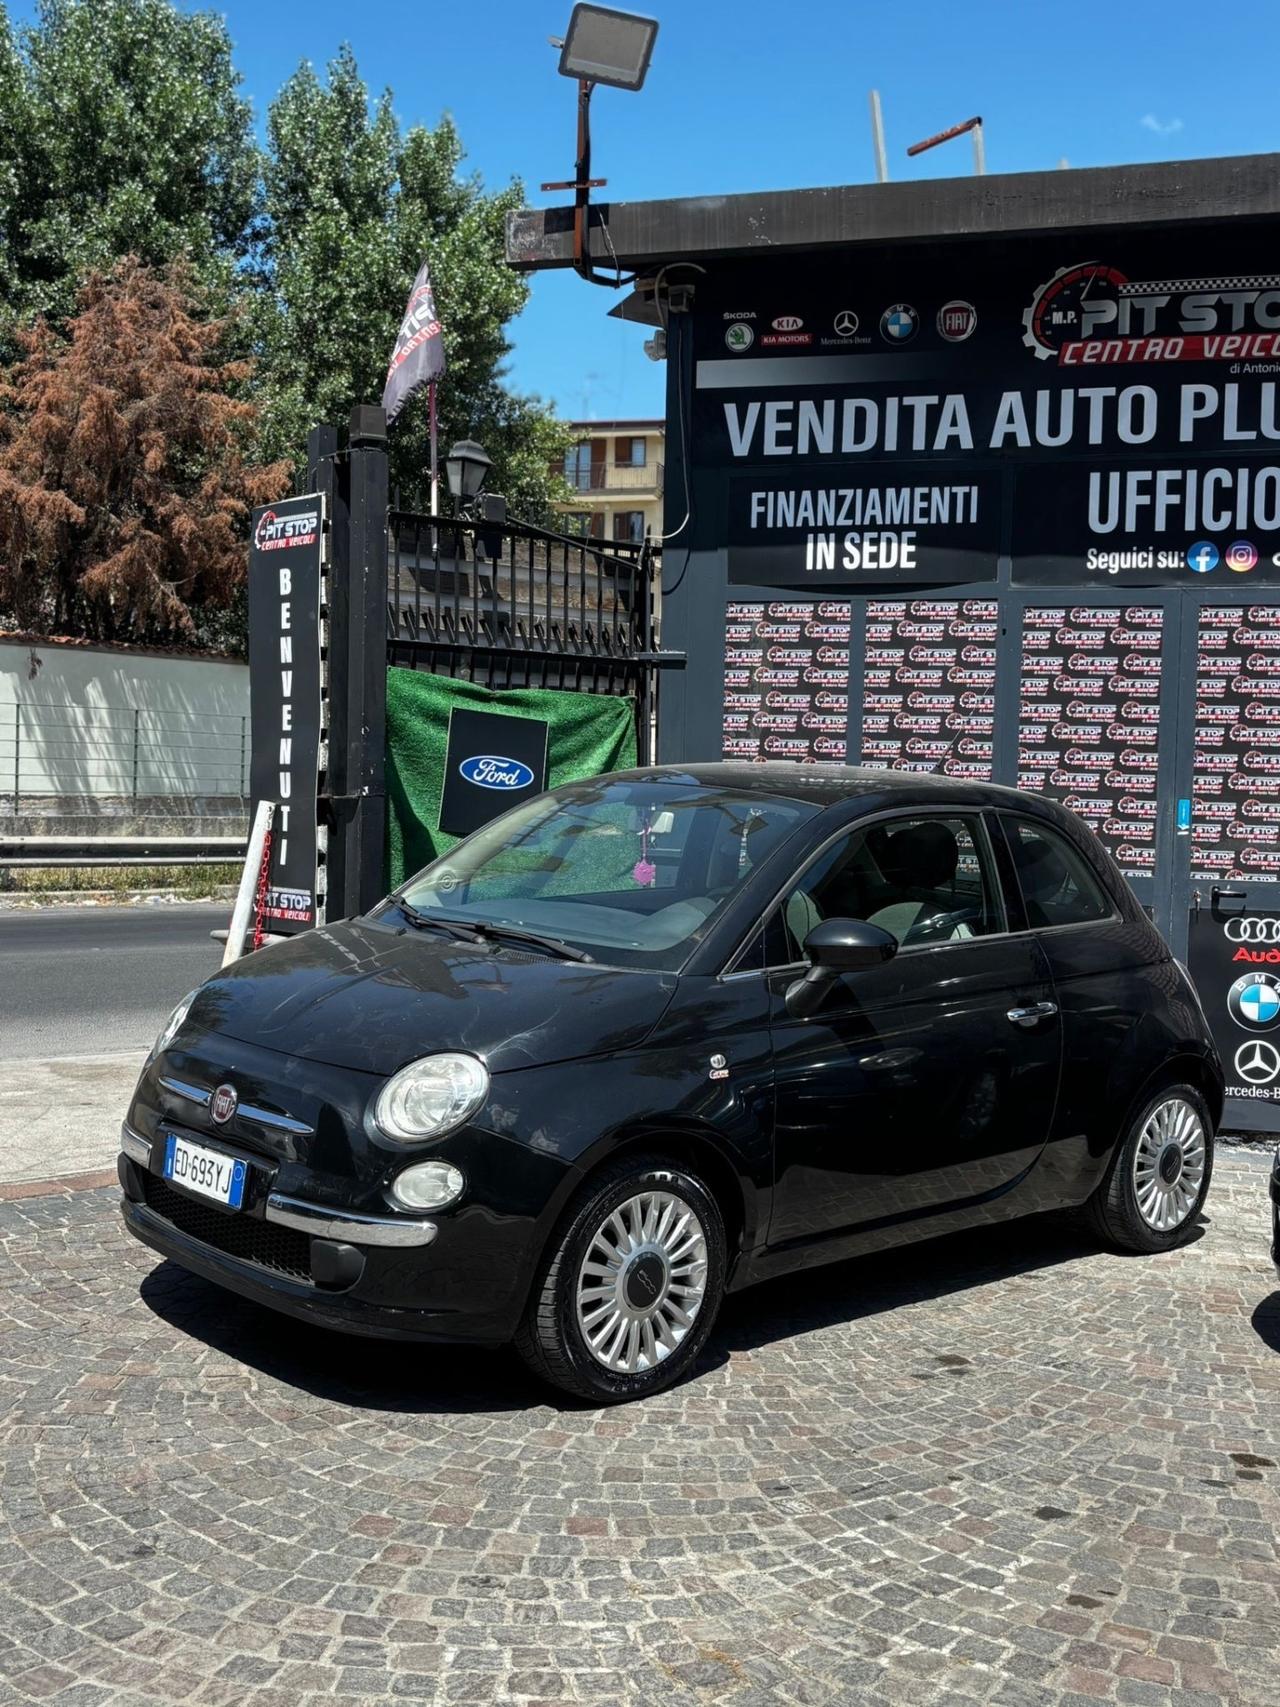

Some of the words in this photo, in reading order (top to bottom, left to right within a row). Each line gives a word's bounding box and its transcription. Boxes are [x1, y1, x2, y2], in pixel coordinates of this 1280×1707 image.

[945, 312, 969, 331] FIAT
[1080, 296, 1171, 339] PIT
[776, 319, 800, 328] KIA
[763, 336, 777, 344] KIA
[778, 334, 810, 343] MOTORS
[1230, 363, 1241, 374] di
[1243, 362, 1280, 373] Antoni
[723, 393, 975, 458] VENDITA
[989, 384, 1158, 449] AUTO
[750, 486, 979, 529] FINANZIAMENTI
[266, 523, 284, 540] PIT
[285, 518, 318, 537] STOP
[806, 538, 836, 570] IN
[842, 531, 917, 569] SEDE
[1087, 546, 1153, 574] Seguici
[1157, 550, 1185, 569] su:
[868, 604, 882, 612] PIT
[883, 604, 906, 612] STOP
[920, 604, 934, 612] PIT
[935, 604, 958, 612] STOP
[279, 568, 293, 866] BENVENUTI
[1023, 728, 1047, 736] STOP
[1061, 728, 1076, 736] PIT
[1077, 728, 1102, 736] STOP
[1116, 728, 1132, 736] PIT
[1133, 728, 1158, 736] STOP
[1020, 753, 1035, 761] PIT
[1036, 753, 1060, 761] STOP
[1074, 753, 1089, 761] PIT
[1091, 753, 1115, 761] STOP
[474, 760, 520, 785] Ford
[1021, 775, 1045, 783] STOP
[1059, 775, 1074, 783] PIT
[1076, 775, 1100, 783] STOP
[1115, 775, 1130, 783] PIT
[1131, 775, 1156, 783] STOP
[280, 894, 311, 910] STOP
[1225, 1085, 1280, 1099] ercedes-B
